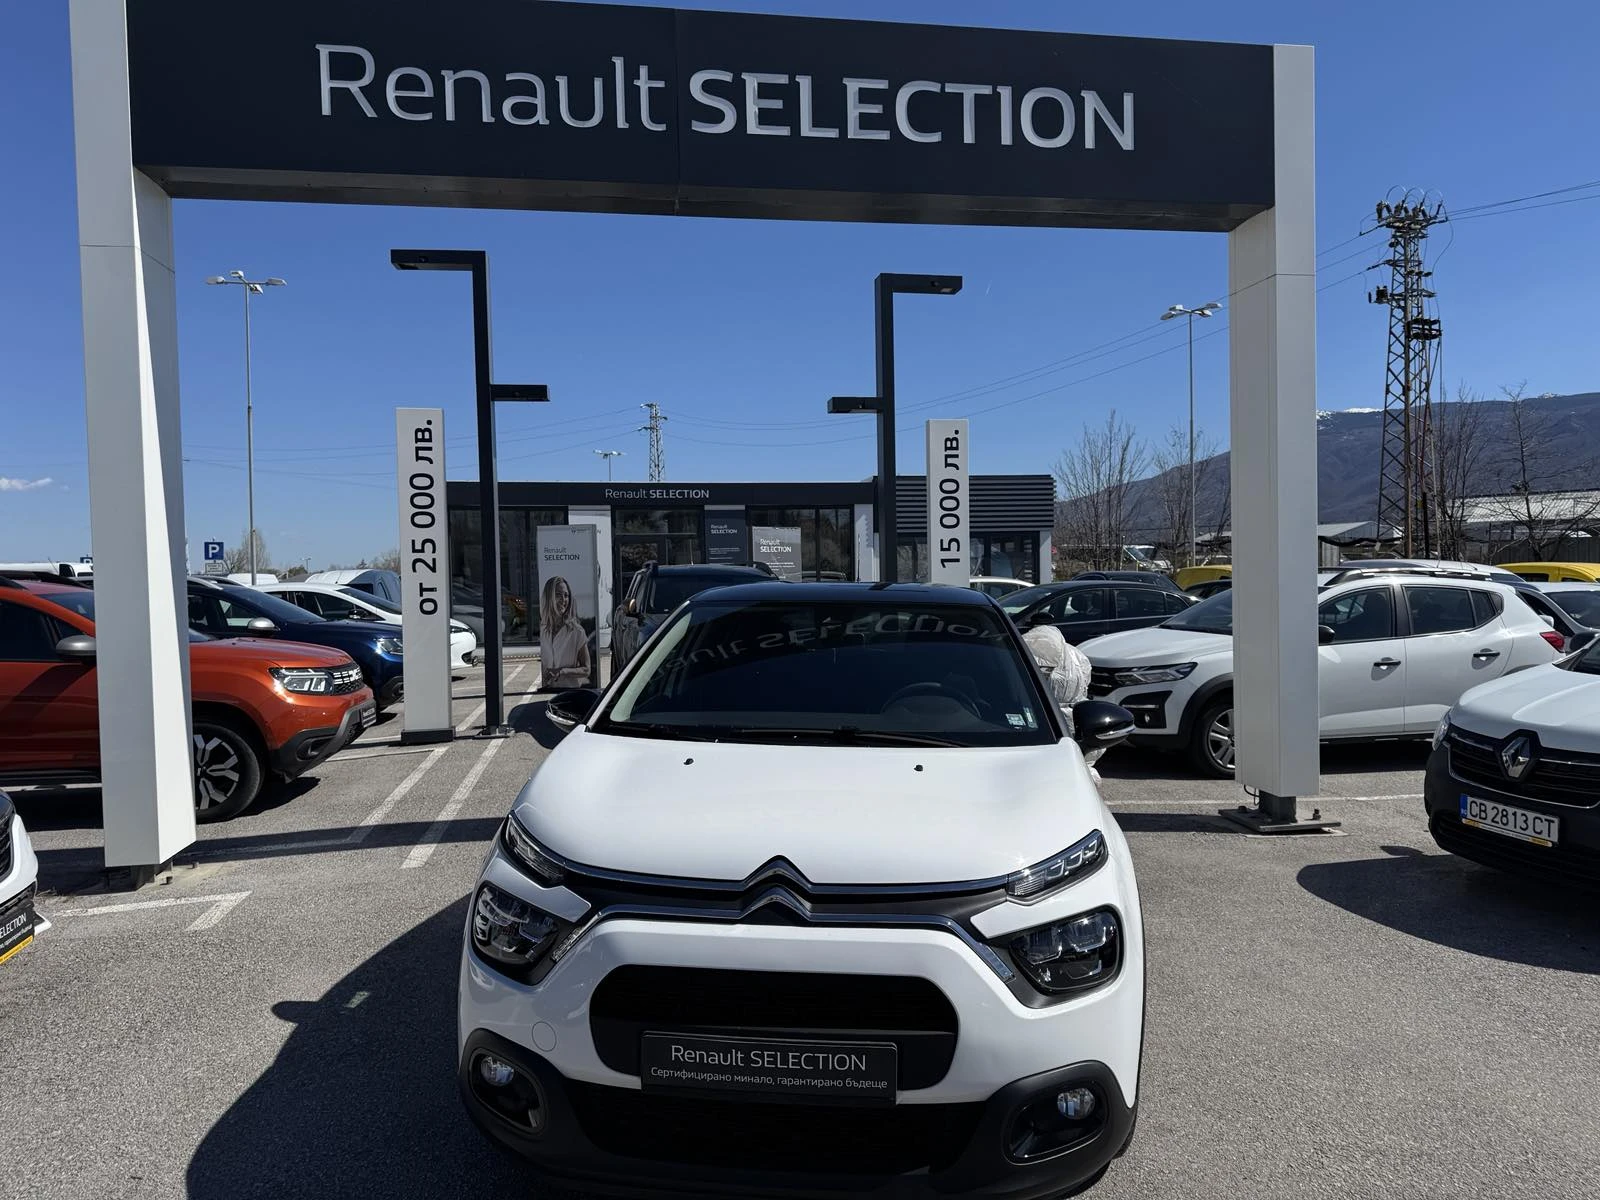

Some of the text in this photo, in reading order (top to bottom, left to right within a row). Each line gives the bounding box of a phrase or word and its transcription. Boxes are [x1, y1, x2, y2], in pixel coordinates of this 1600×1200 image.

[315, 43, 1135, 151] Renault SELECTION
[605, 488, 710, 499] Renault SELECTION
[939, 429, 961, 569] 15 000 лв.
[409, 419, 438, 616] от 25 000 лв.
[208, 544, 220, 558] P
[1469, 800, 1488, 820] CB
[1491, 806, 1529, 832] 2813
[1532, 816, 1555, 838] CT
[671, 1045, 867, 1071] Renault SELECTION
[651, 1067, 888, 1089] Сертифицирано минало, гарантирано бъдеще
